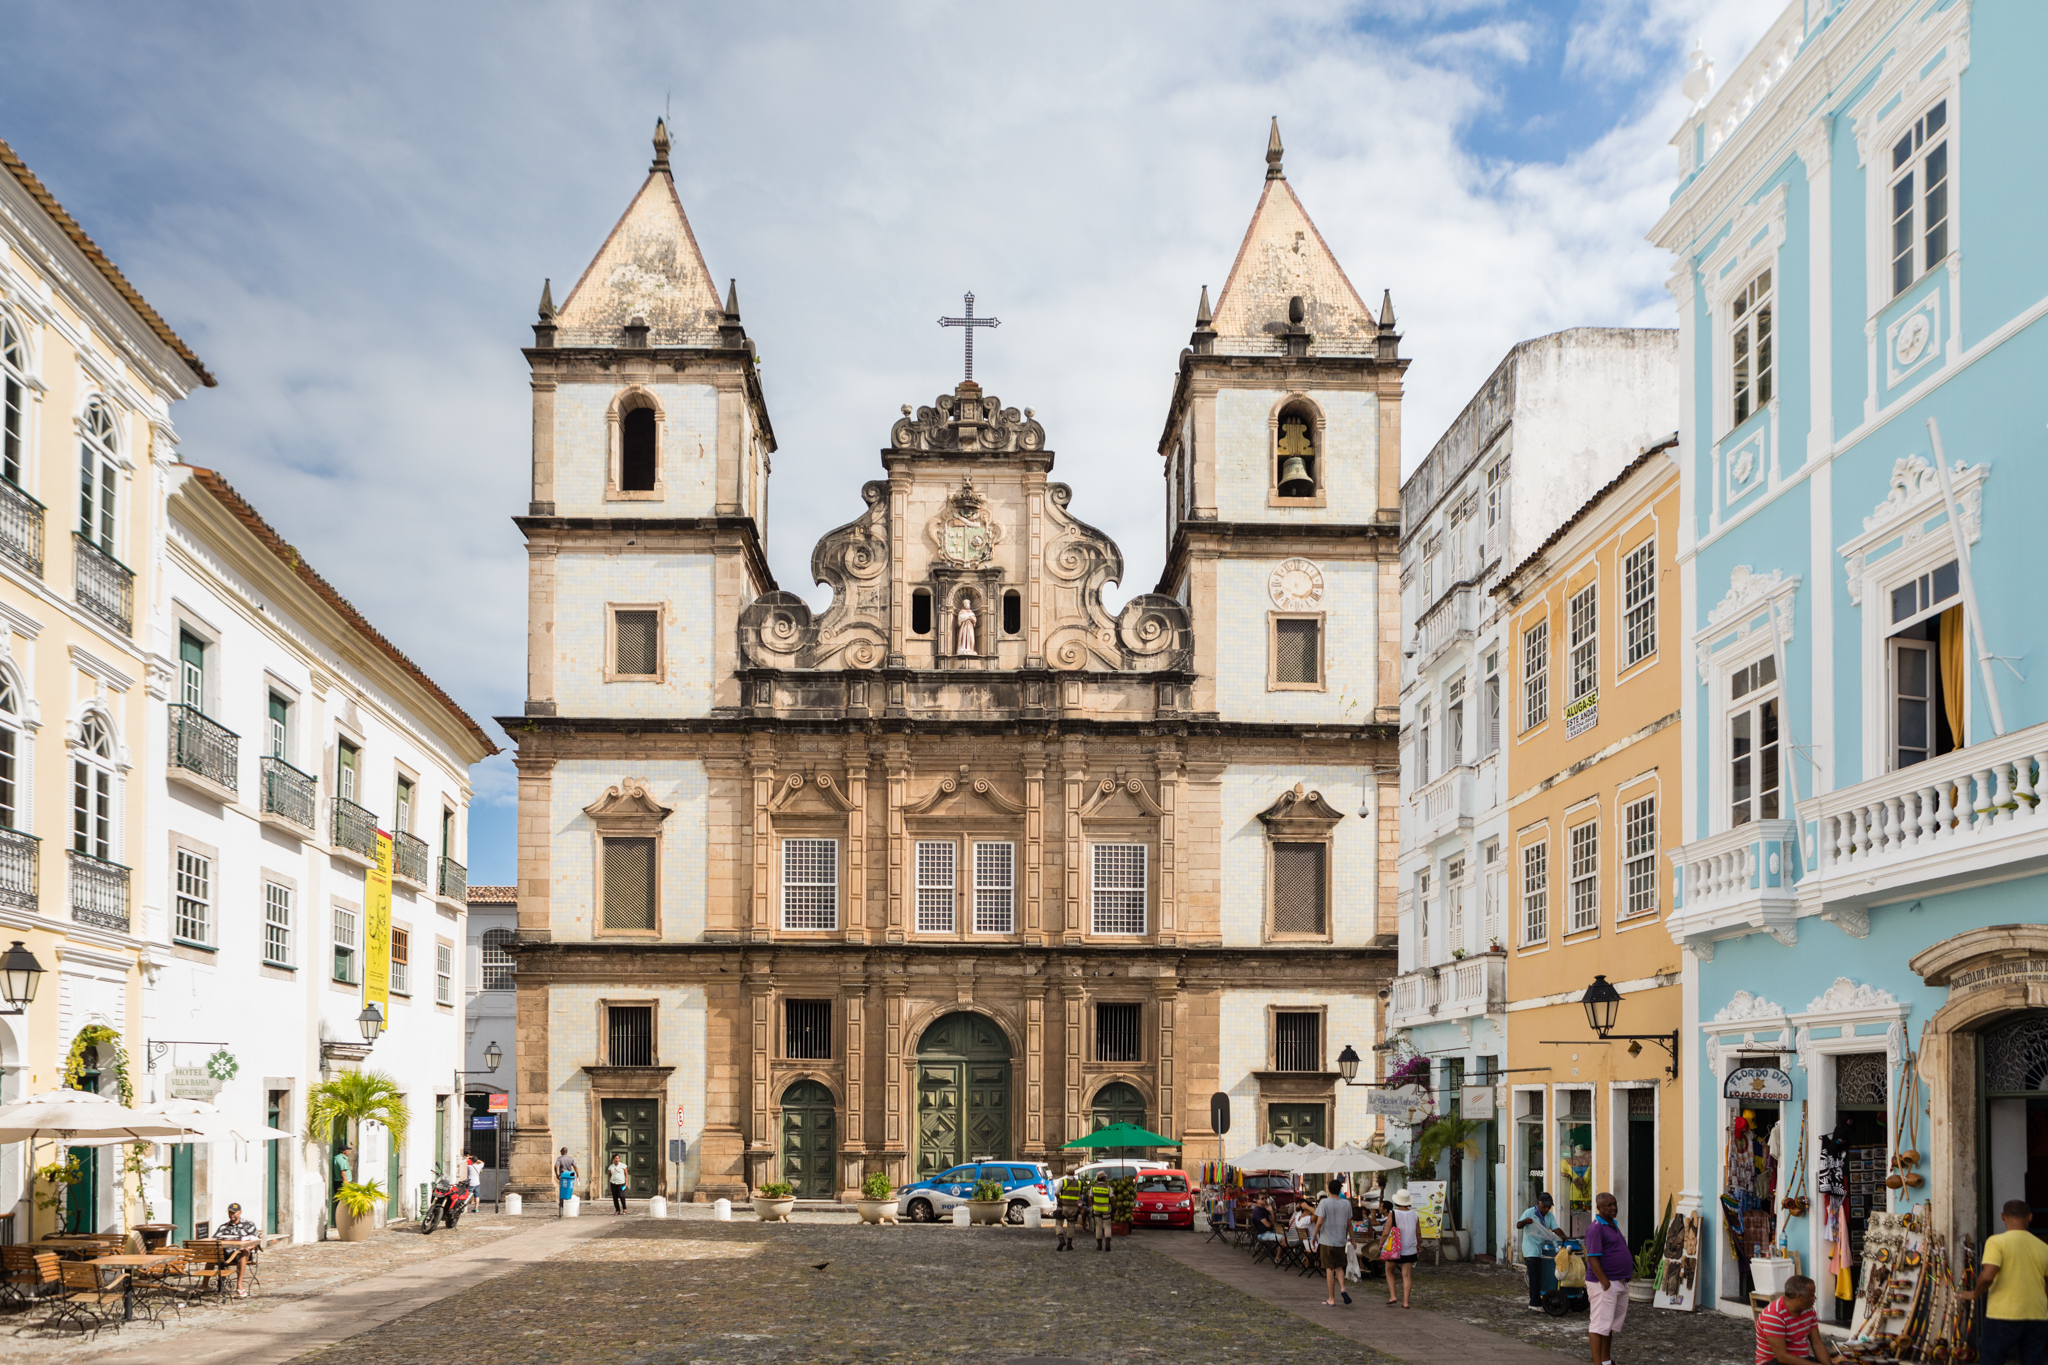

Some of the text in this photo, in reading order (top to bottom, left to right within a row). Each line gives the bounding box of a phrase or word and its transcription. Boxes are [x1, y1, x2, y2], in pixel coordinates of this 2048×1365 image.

[1566, 705, 1598, 728] ESTE ANDAR
[1567, 693, 1597, 719] ALUGA-SE
[1950, 968, 1985, 991] SOCIEDADE
[1986, 961, 2028, 979] PROTECTORA
[2029, 960, 2043, 972] DOS
[175, 1068, 204, 1076] HOTEL
[1771, 1070, 1789, 1087] DIA
